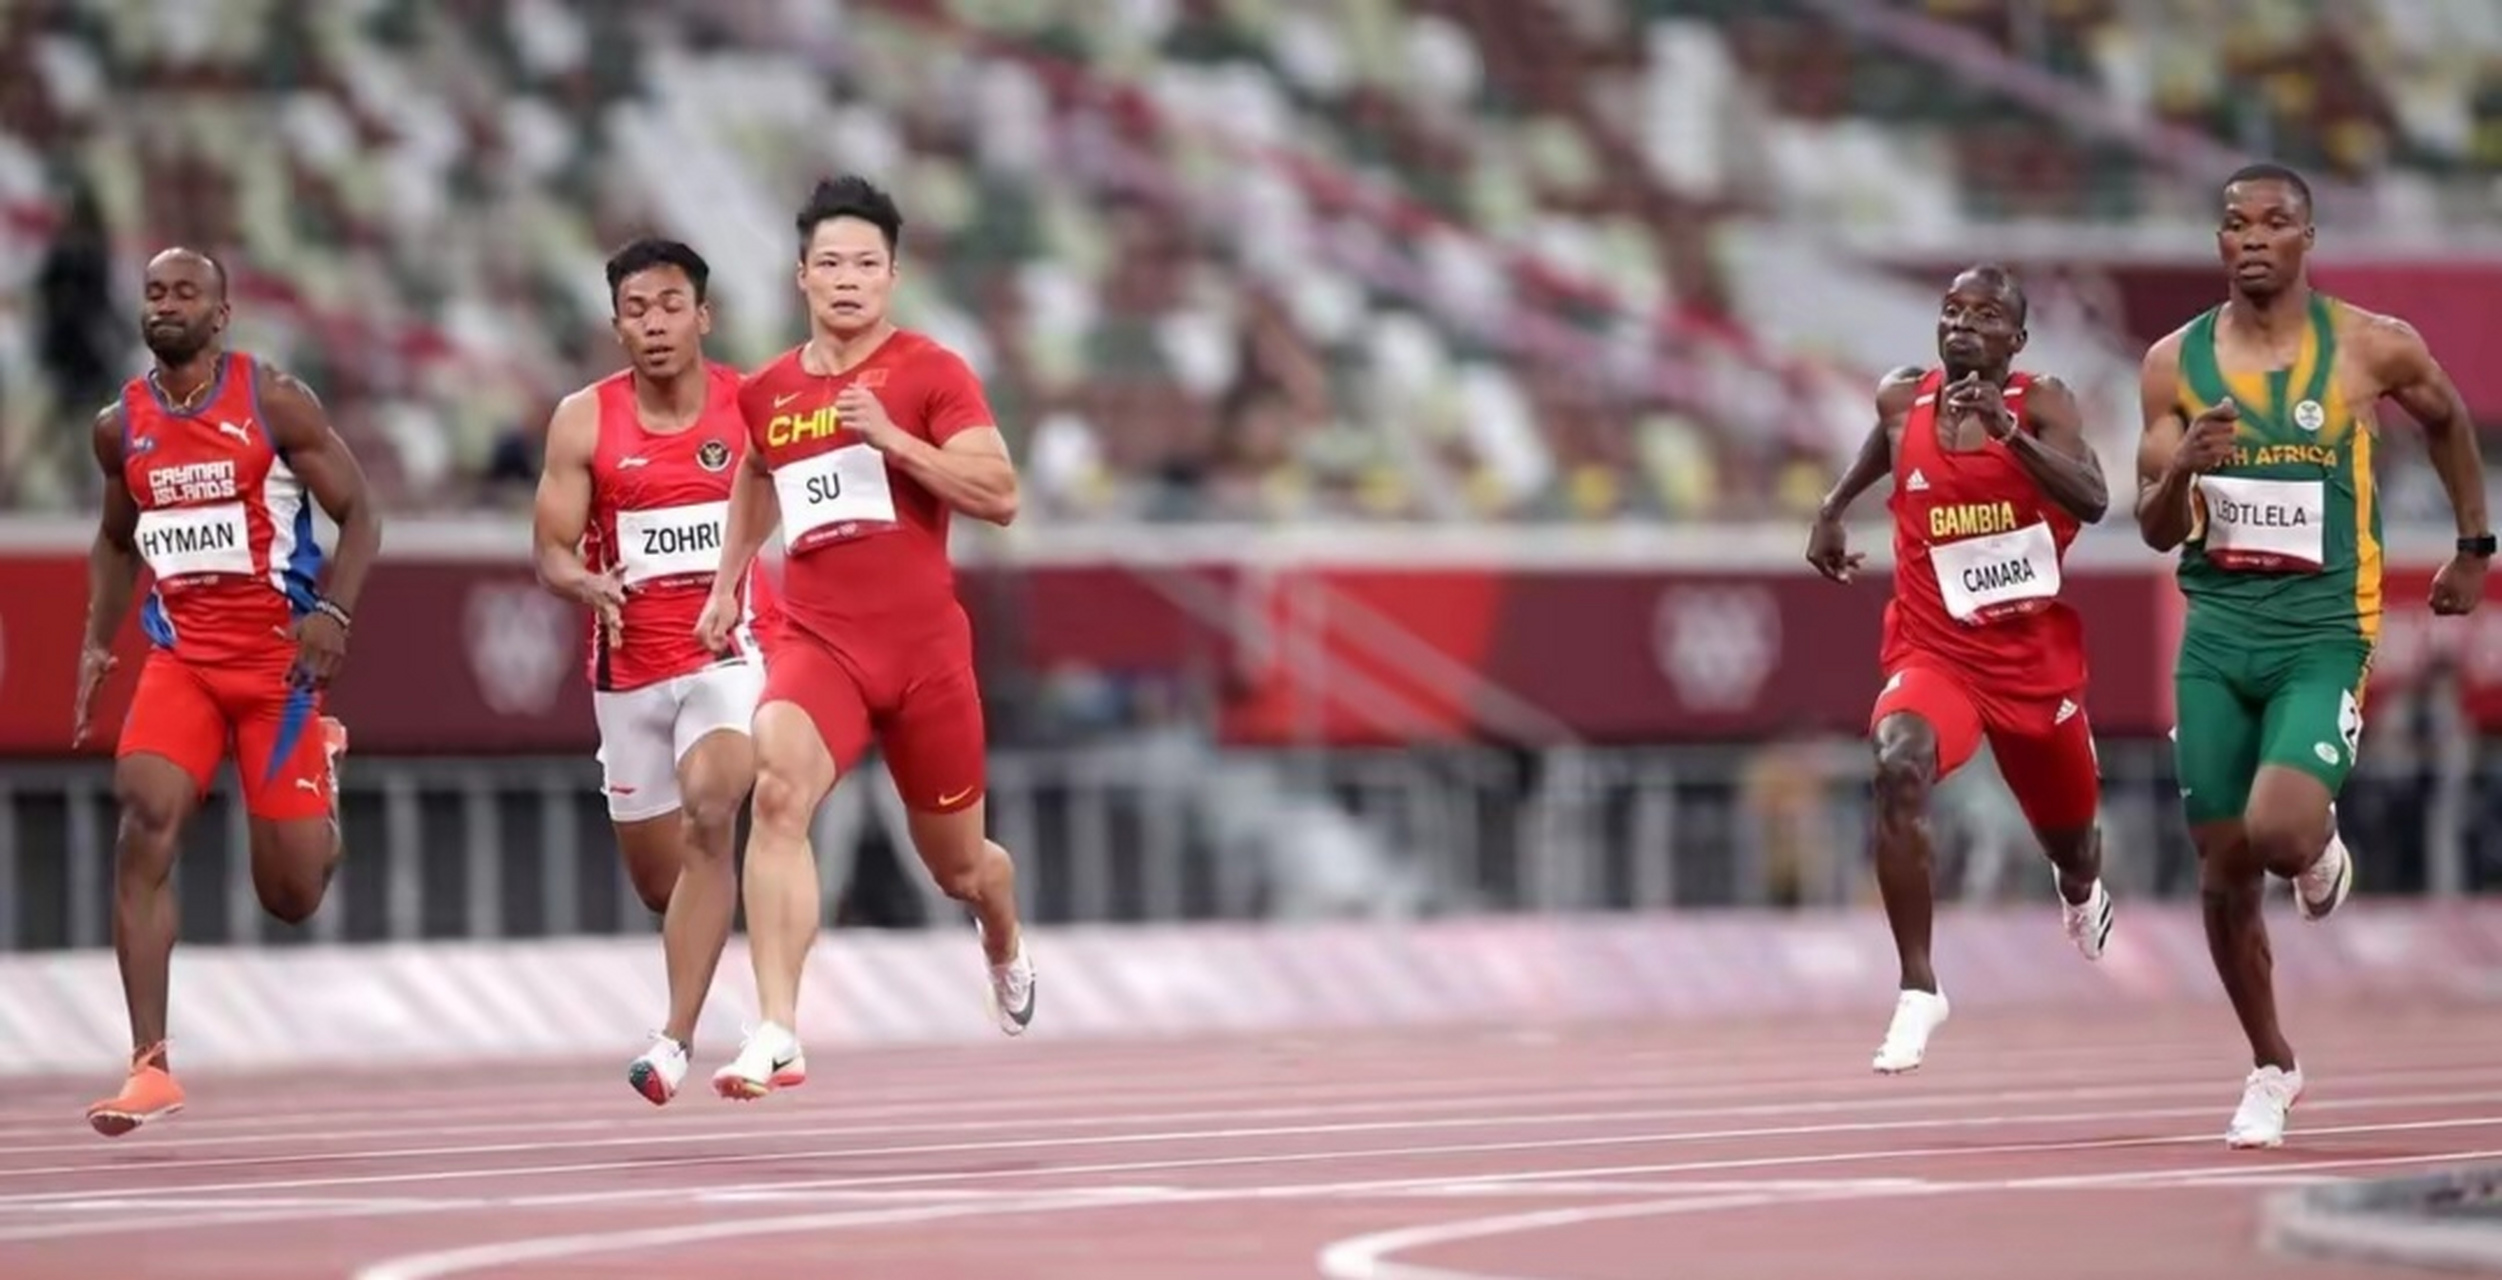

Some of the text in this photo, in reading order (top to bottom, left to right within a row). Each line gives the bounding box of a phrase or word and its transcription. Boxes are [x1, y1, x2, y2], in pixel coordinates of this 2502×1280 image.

[2254, 444, 2338, 468] AFRICA
[148, 460, 235, 490] CAYMAN
[806, 472, 841, 505] SU
[153, 479, 238, 506] ISLANDS
[1929, 501, 2017, 537] GAMBIA
[142, 521, 235, 558] HYMAN
[642, 521, 721, 555] ZOHRI
[1962, 557, 2036, 593] CAMARA
